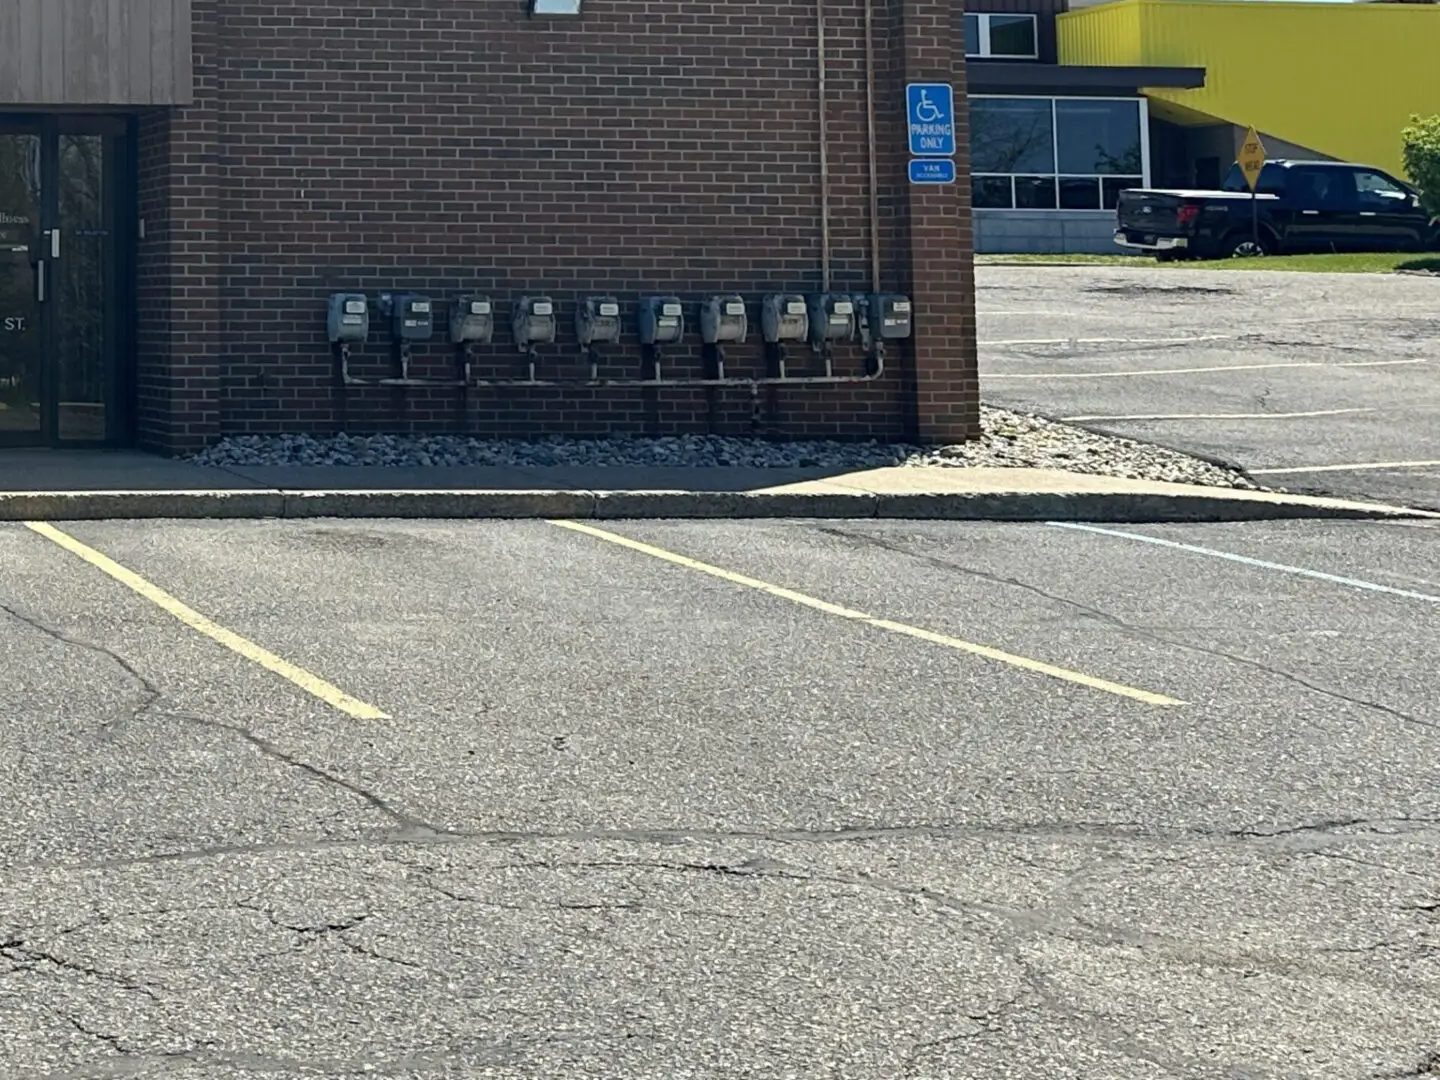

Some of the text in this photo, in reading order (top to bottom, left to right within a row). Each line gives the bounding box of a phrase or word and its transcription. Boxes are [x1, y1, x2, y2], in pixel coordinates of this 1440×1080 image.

[911, 123, 951, 135] PARKING
[920, 137, 944, 149] ONLY
[4, 317, 26, 330] ST.
